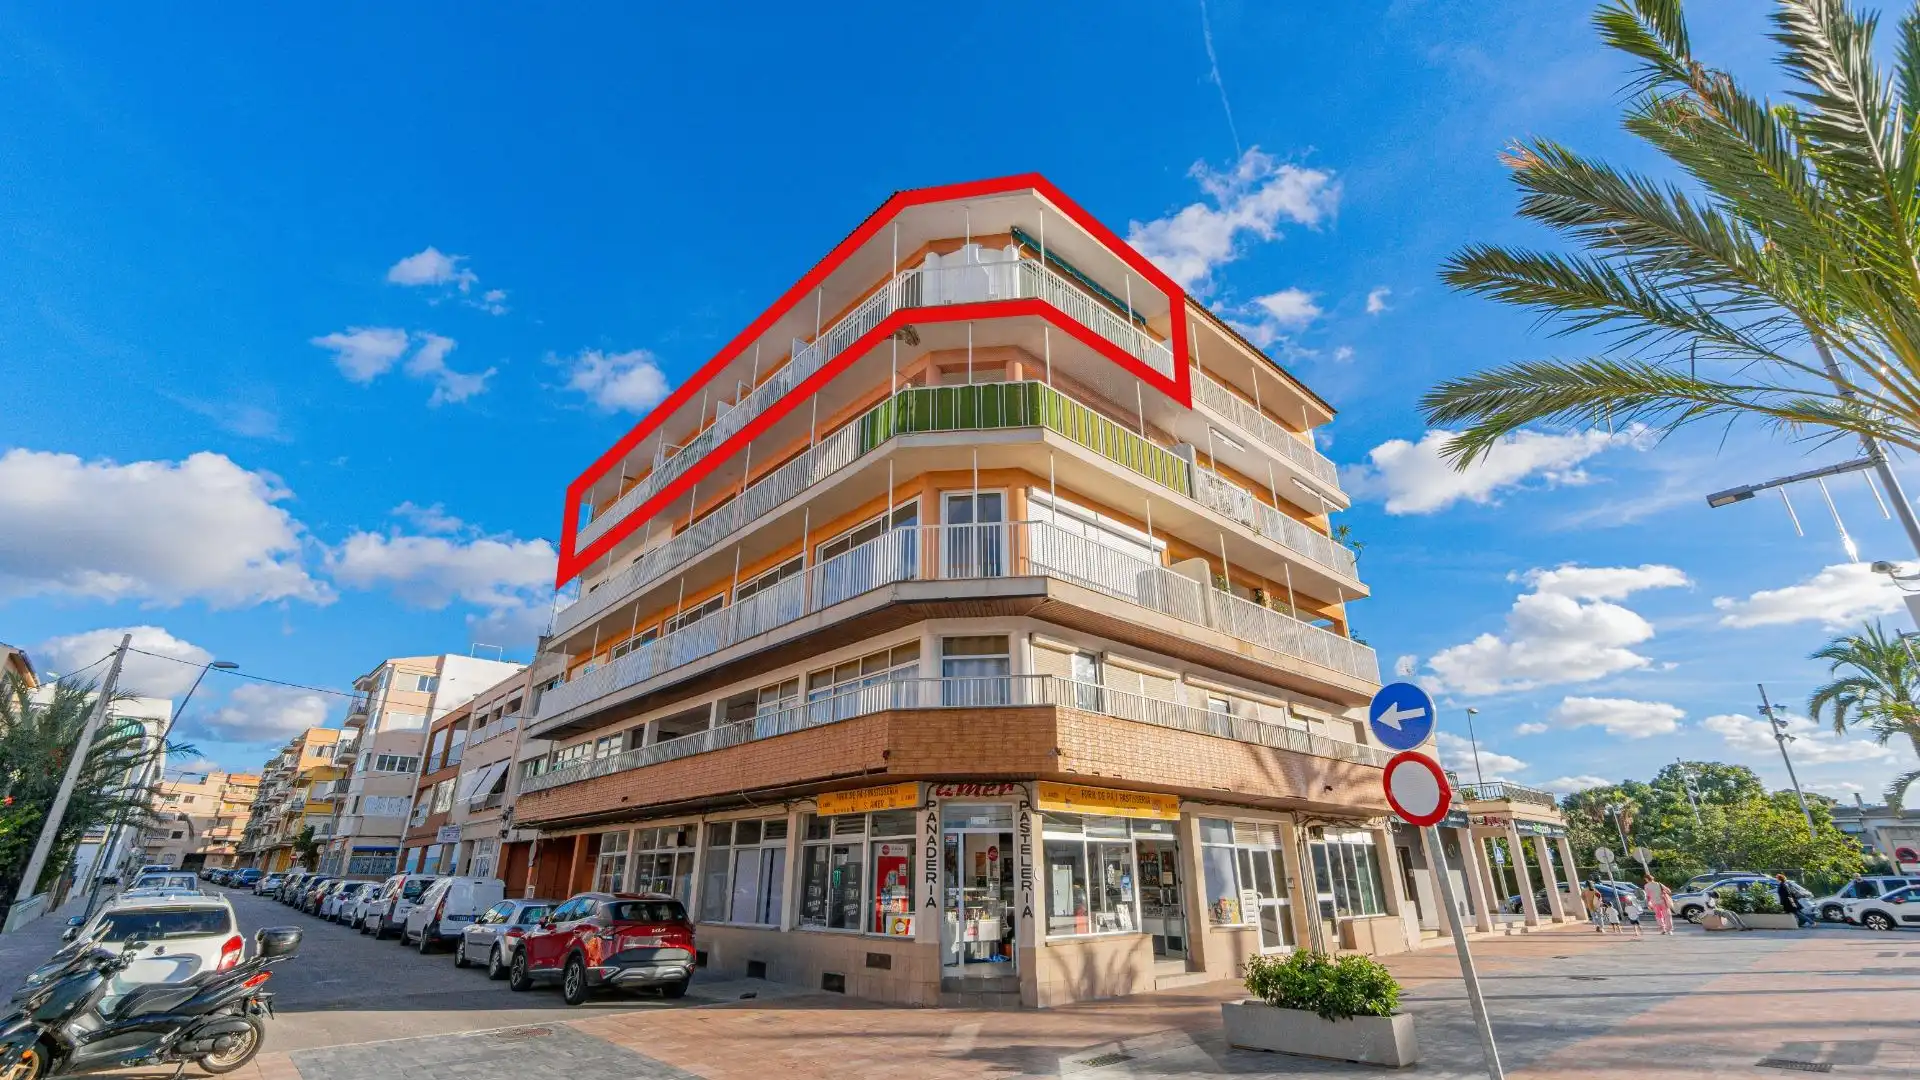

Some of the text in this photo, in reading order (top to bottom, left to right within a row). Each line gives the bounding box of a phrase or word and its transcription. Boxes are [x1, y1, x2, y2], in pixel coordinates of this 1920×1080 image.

[1097, 790, 1105, 801] DE
[925, 801, 937, 908] PANADERIA
[1019, 801, 1033, 918] PASTELERIA
